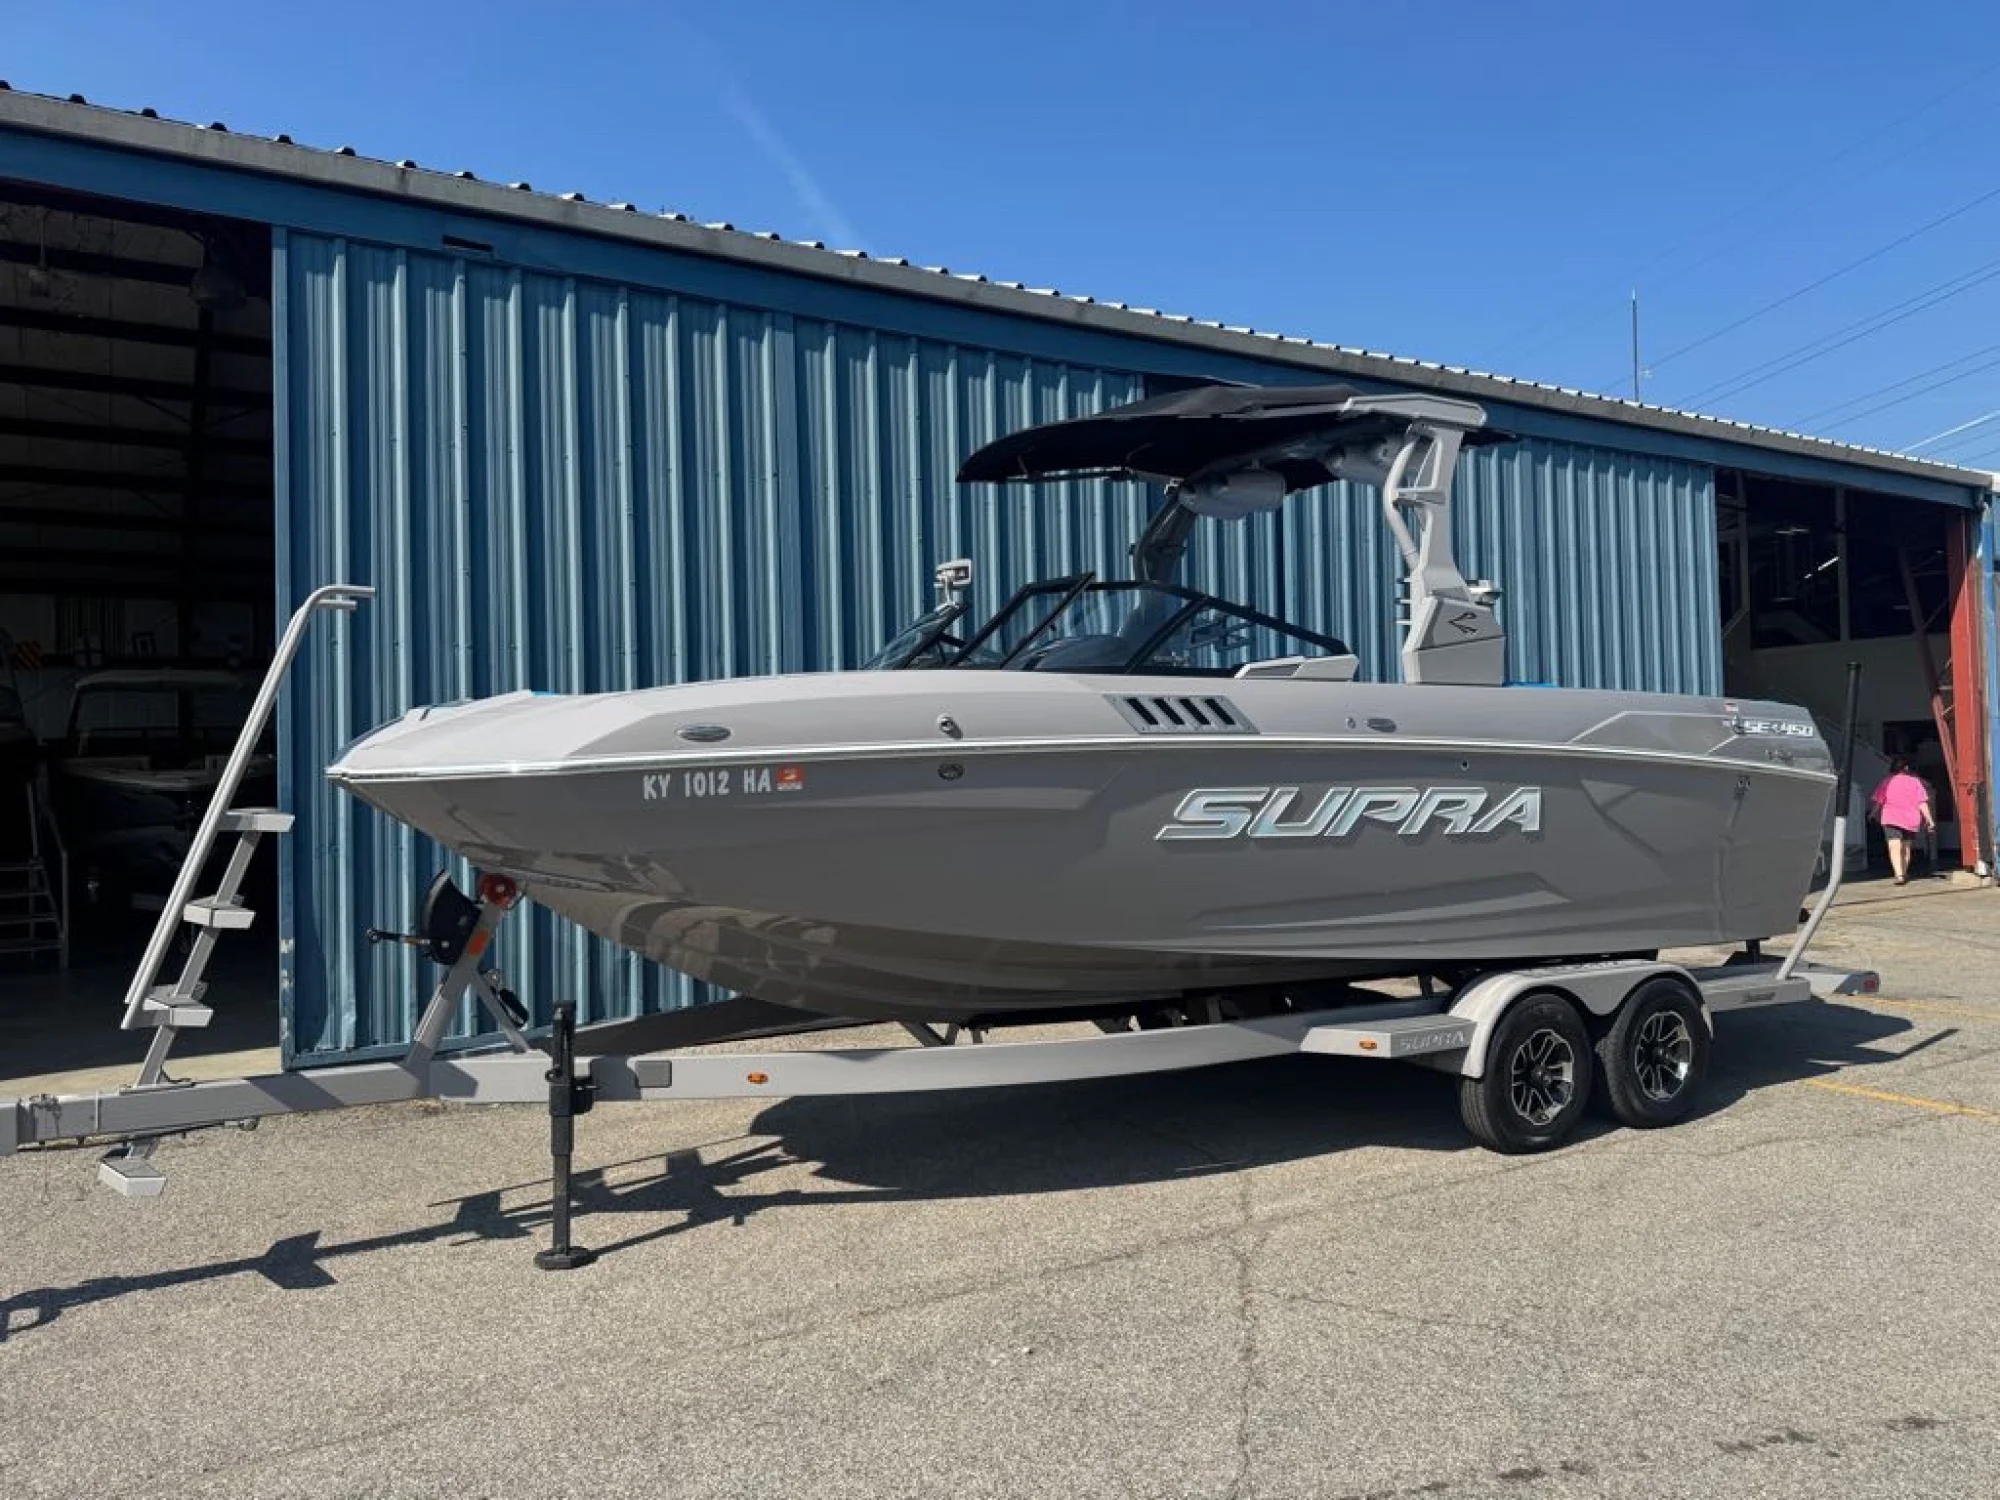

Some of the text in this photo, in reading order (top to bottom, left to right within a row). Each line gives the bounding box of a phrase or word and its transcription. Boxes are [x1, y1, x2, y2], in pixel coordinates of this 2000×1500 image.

[642, 773, 671, 800] KY
[684, 769, 731, 798] 1012
[743, 767, 772, 793] HA
[1154, 786, 1542, 841] SUPRA
